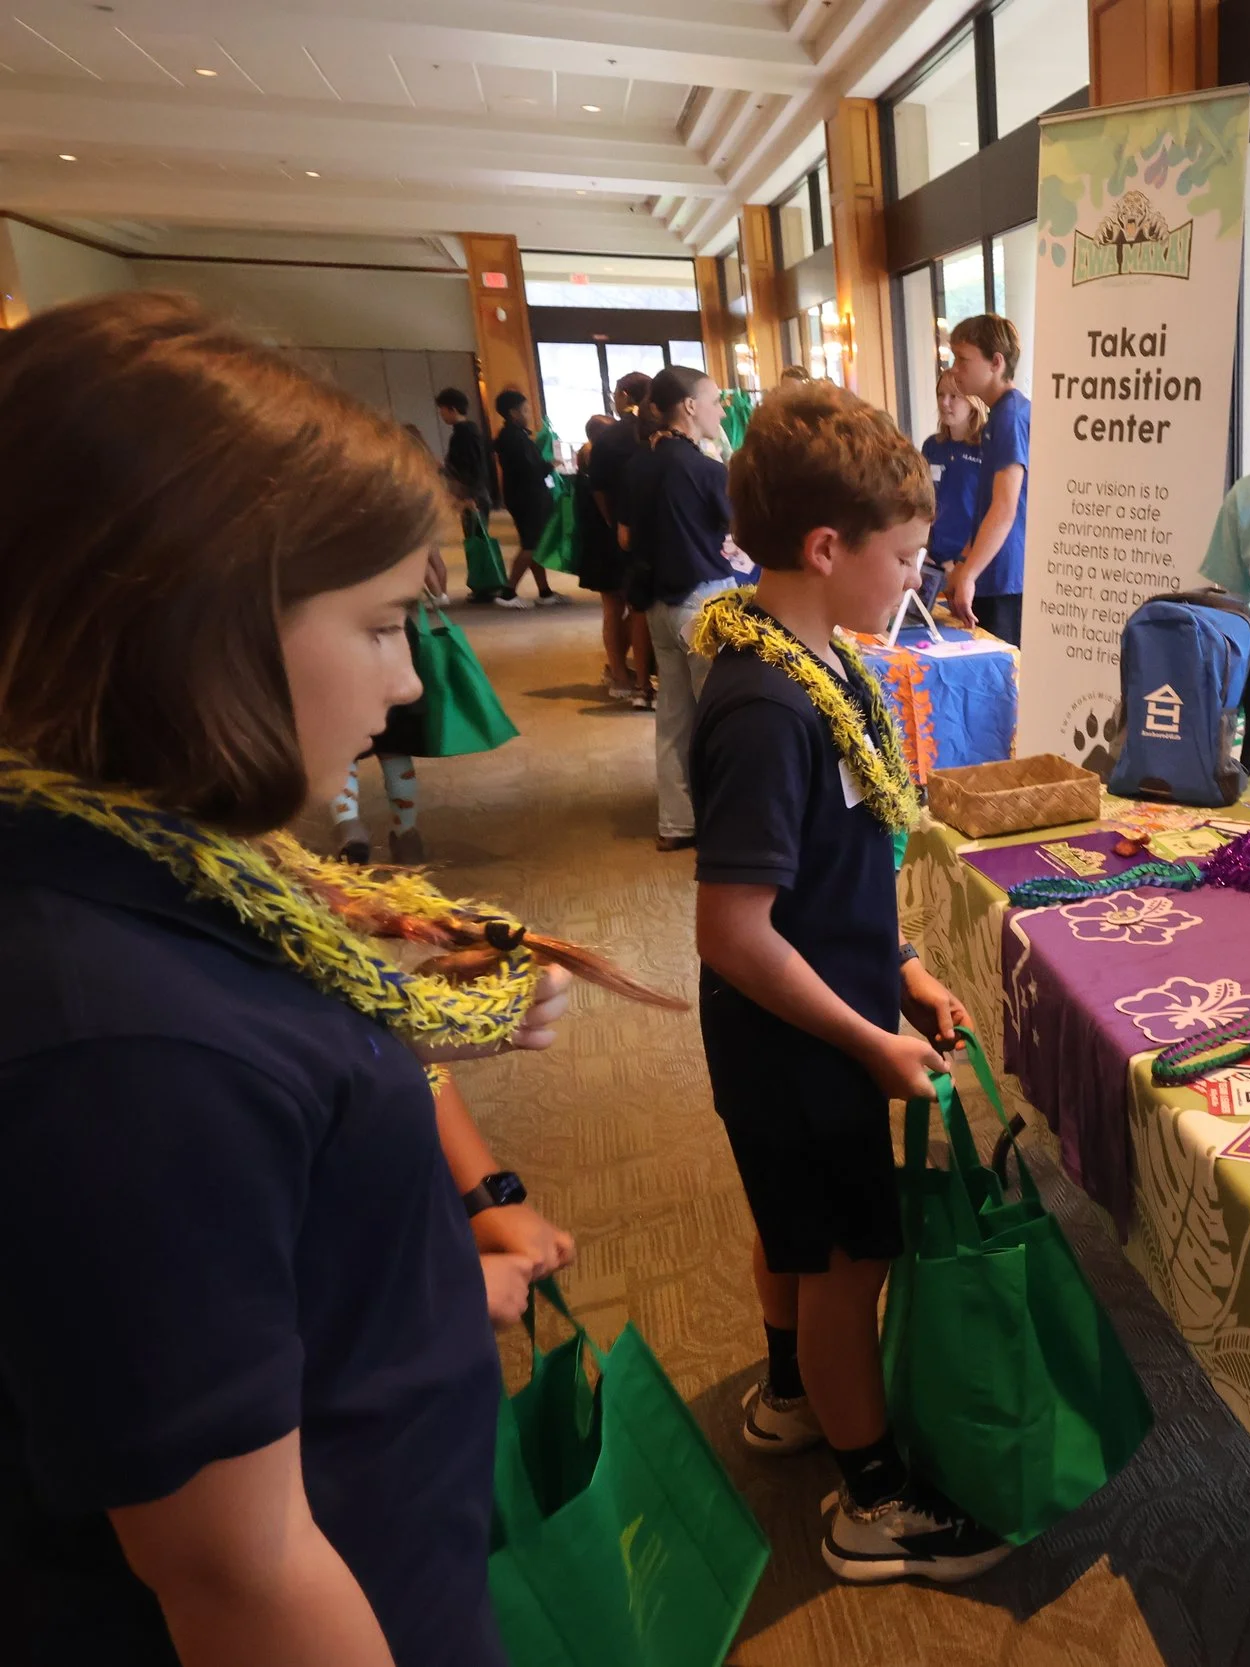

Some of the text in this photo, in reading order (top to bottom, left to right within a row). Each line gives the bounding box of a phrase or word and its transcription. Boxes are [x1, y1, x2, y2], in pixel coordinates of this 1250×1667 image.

[1087, 323, 1167, 357] Takai
[1051, 367, 1202, 401] Transition
[1073, 414, 1171, 443] Center
[1066, 479, 1169, 501] Our vision is to
[1071, 499, 1161, 521] foster a safe
[1058, 521, 1173, 545] environment for
[1053, 540, 1109, 560] students
[1113, 545, 1127, 561] to
[1047, 559, 1180, 592] bring a welcoming
[1100, 588, 1128, 604] and
[1040, 598, 1088, 622] healthy
[1051, 622, 1078, 638] with
[1066, 645, 1092, 661] and
